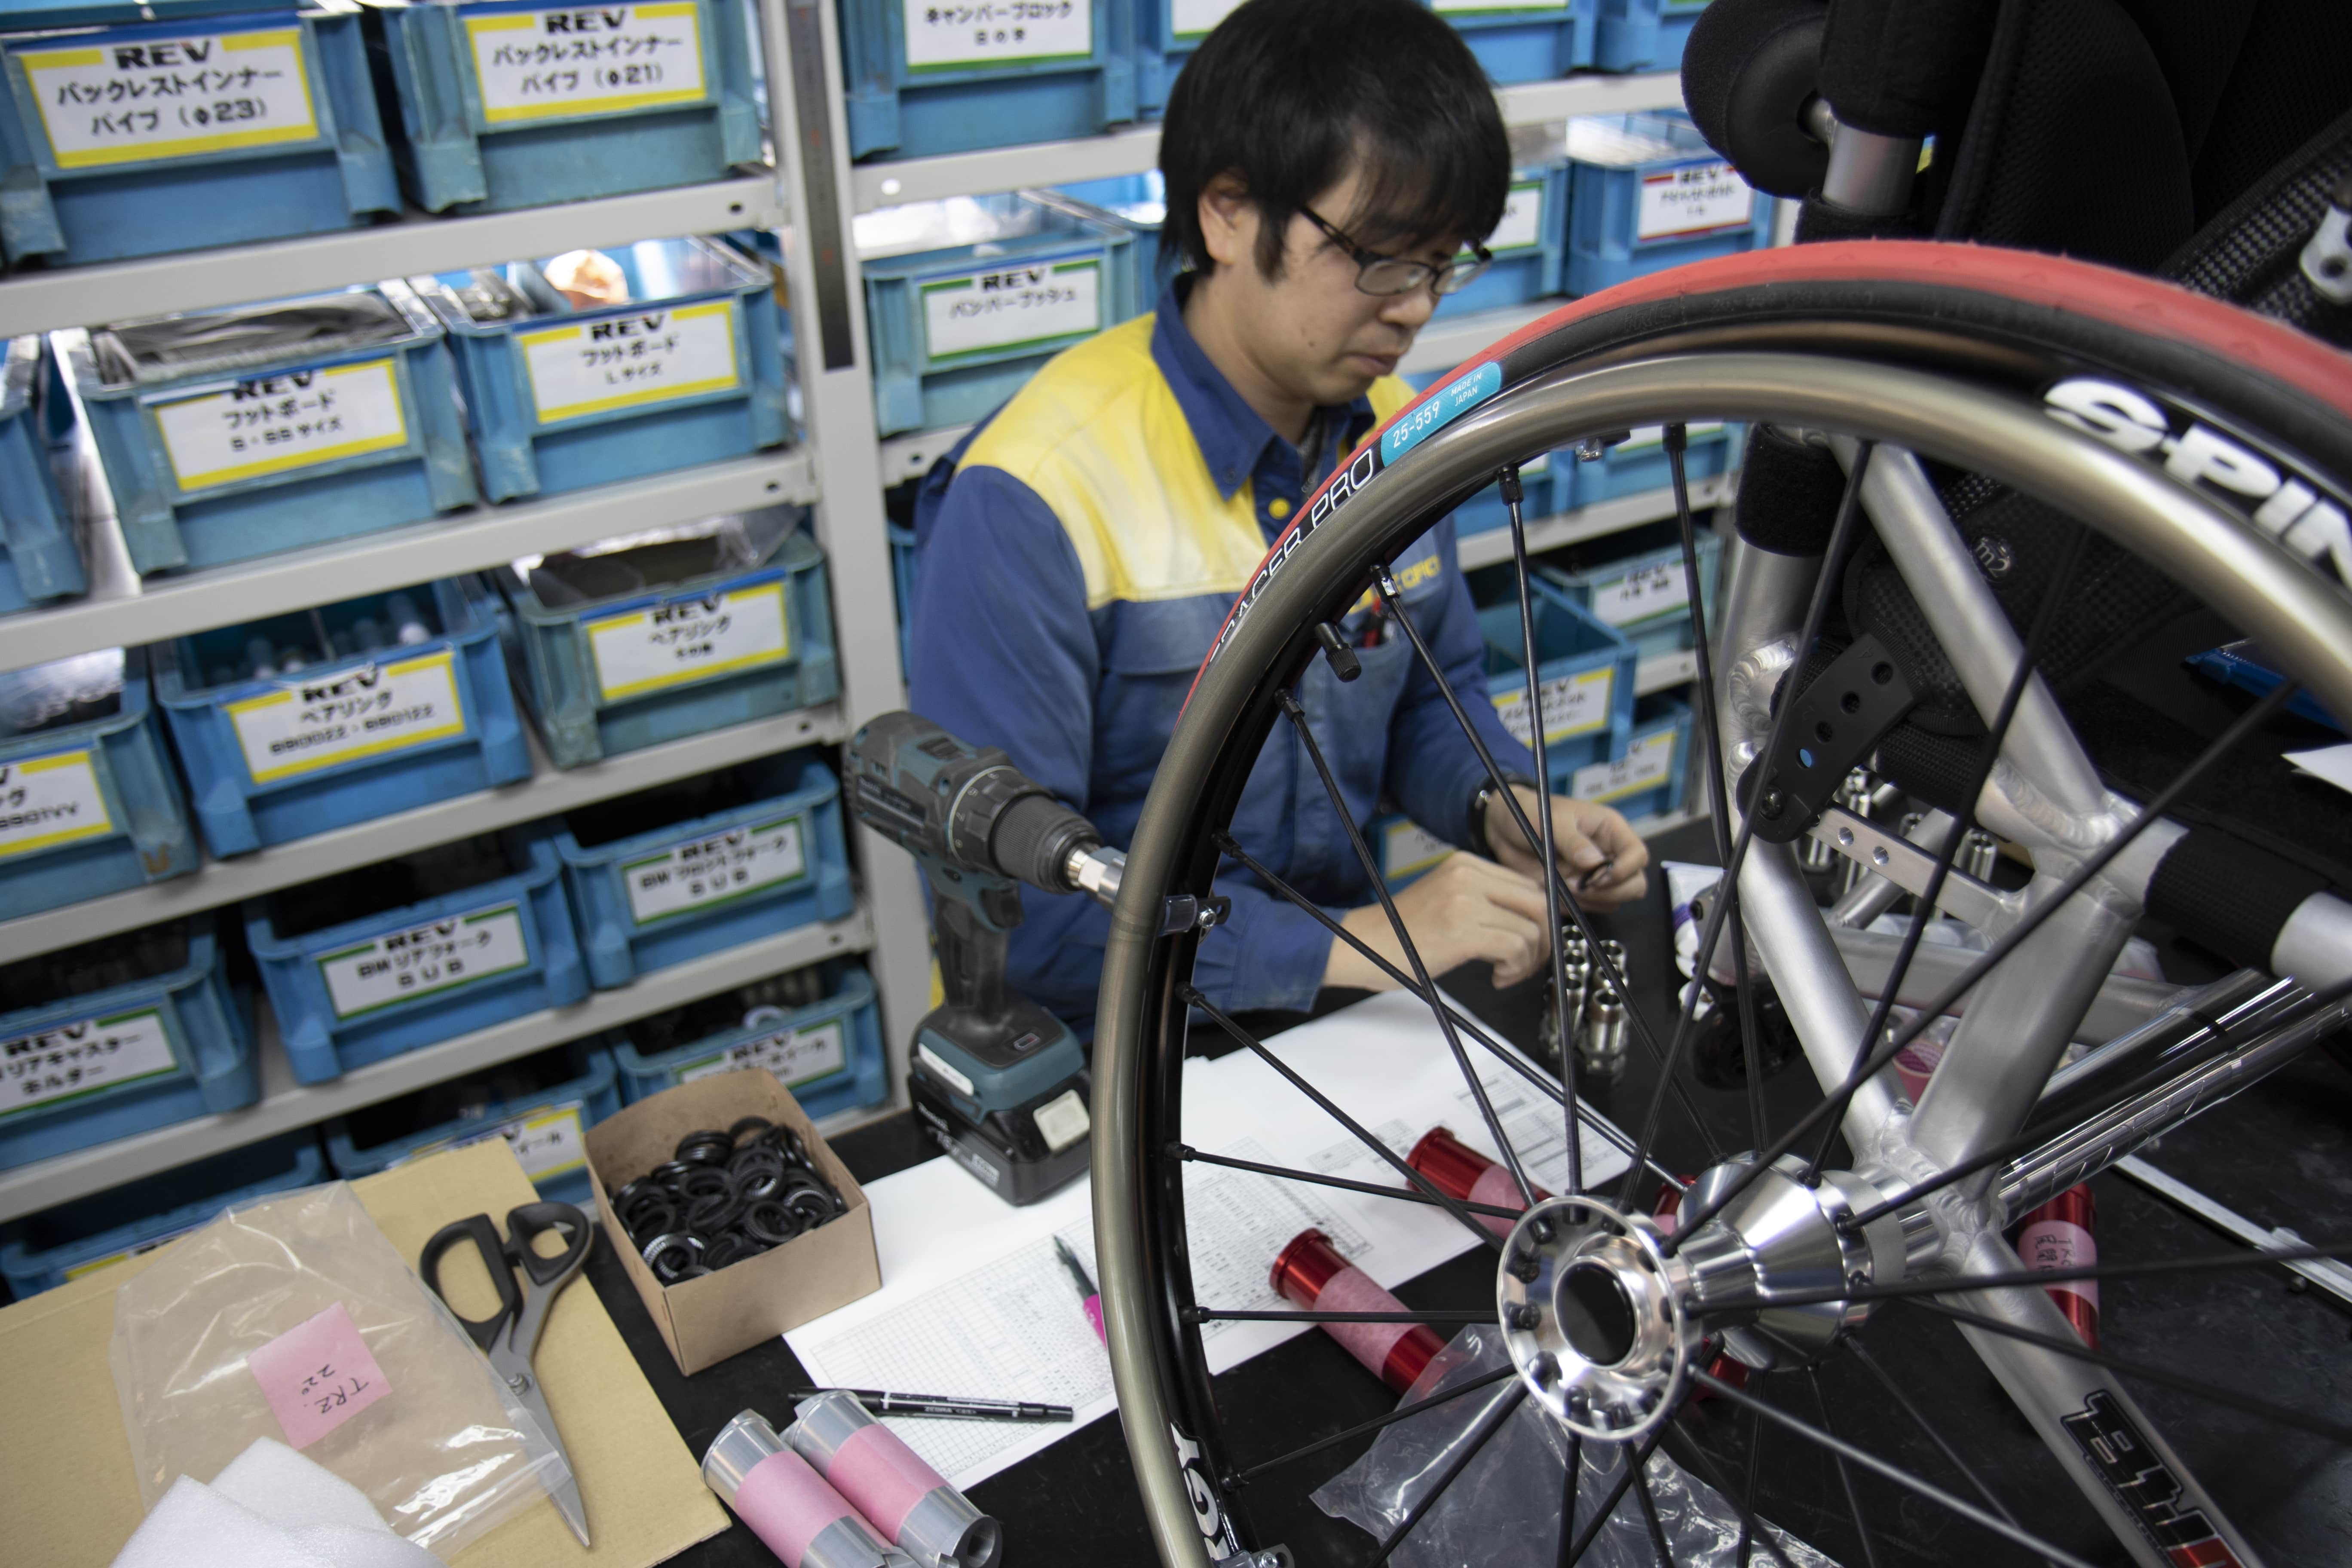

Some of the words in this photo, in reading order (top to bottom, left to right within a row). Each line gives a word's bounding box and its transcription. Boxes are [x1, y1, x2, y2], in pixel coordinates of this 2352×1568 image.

[547, 9, 628, 34] REV
[114, 40, 211, 70] REV
[493, 35, 682, 66] バックレストインナー
[58, 67, 284, 106] バックレストインナー
[983, 268, 1045, 291] REV
[590, 313, 666, 341] REV
[1451, 378, 1472, 397] MADE
[1473, 372, 1482, 383] IN
[1455, 385, 1478, 407] JAPAN
[223, 390, 337, 429] フットボード
[1393, 400, 1440, 448] 25-559
[1311, 448, 1373, 529] PRO
[301, 689, 393, 723] ベアリング
[385, 918, 457, 951] REV
[5, 1021, 89, 1057] REV
